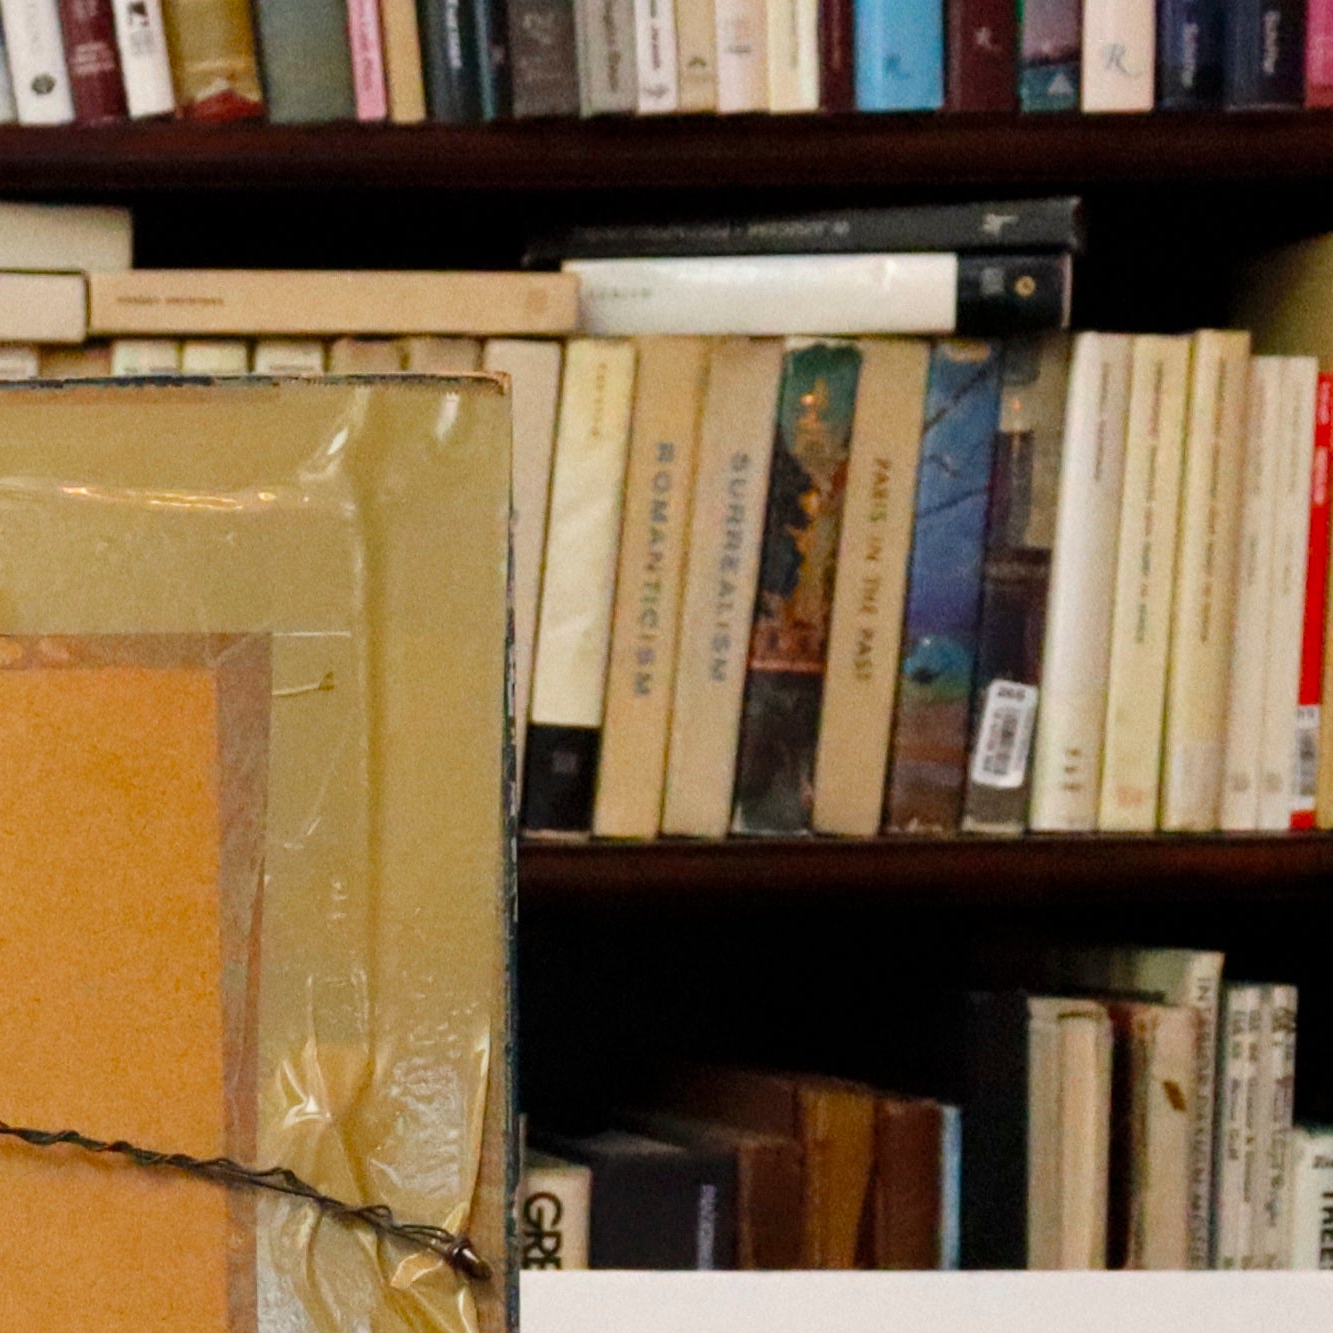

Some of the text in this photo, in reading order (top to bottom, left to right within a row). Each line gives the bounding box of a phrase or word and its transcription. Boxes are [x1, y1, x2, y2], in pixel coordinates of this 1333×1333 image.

[870, 456, 891, 524] PARIS
[634, 442, 676, 696] ROMANTICISM
[709, 453, 749, 682] SURREALISM
[854, 624, 877, 685] PAST
